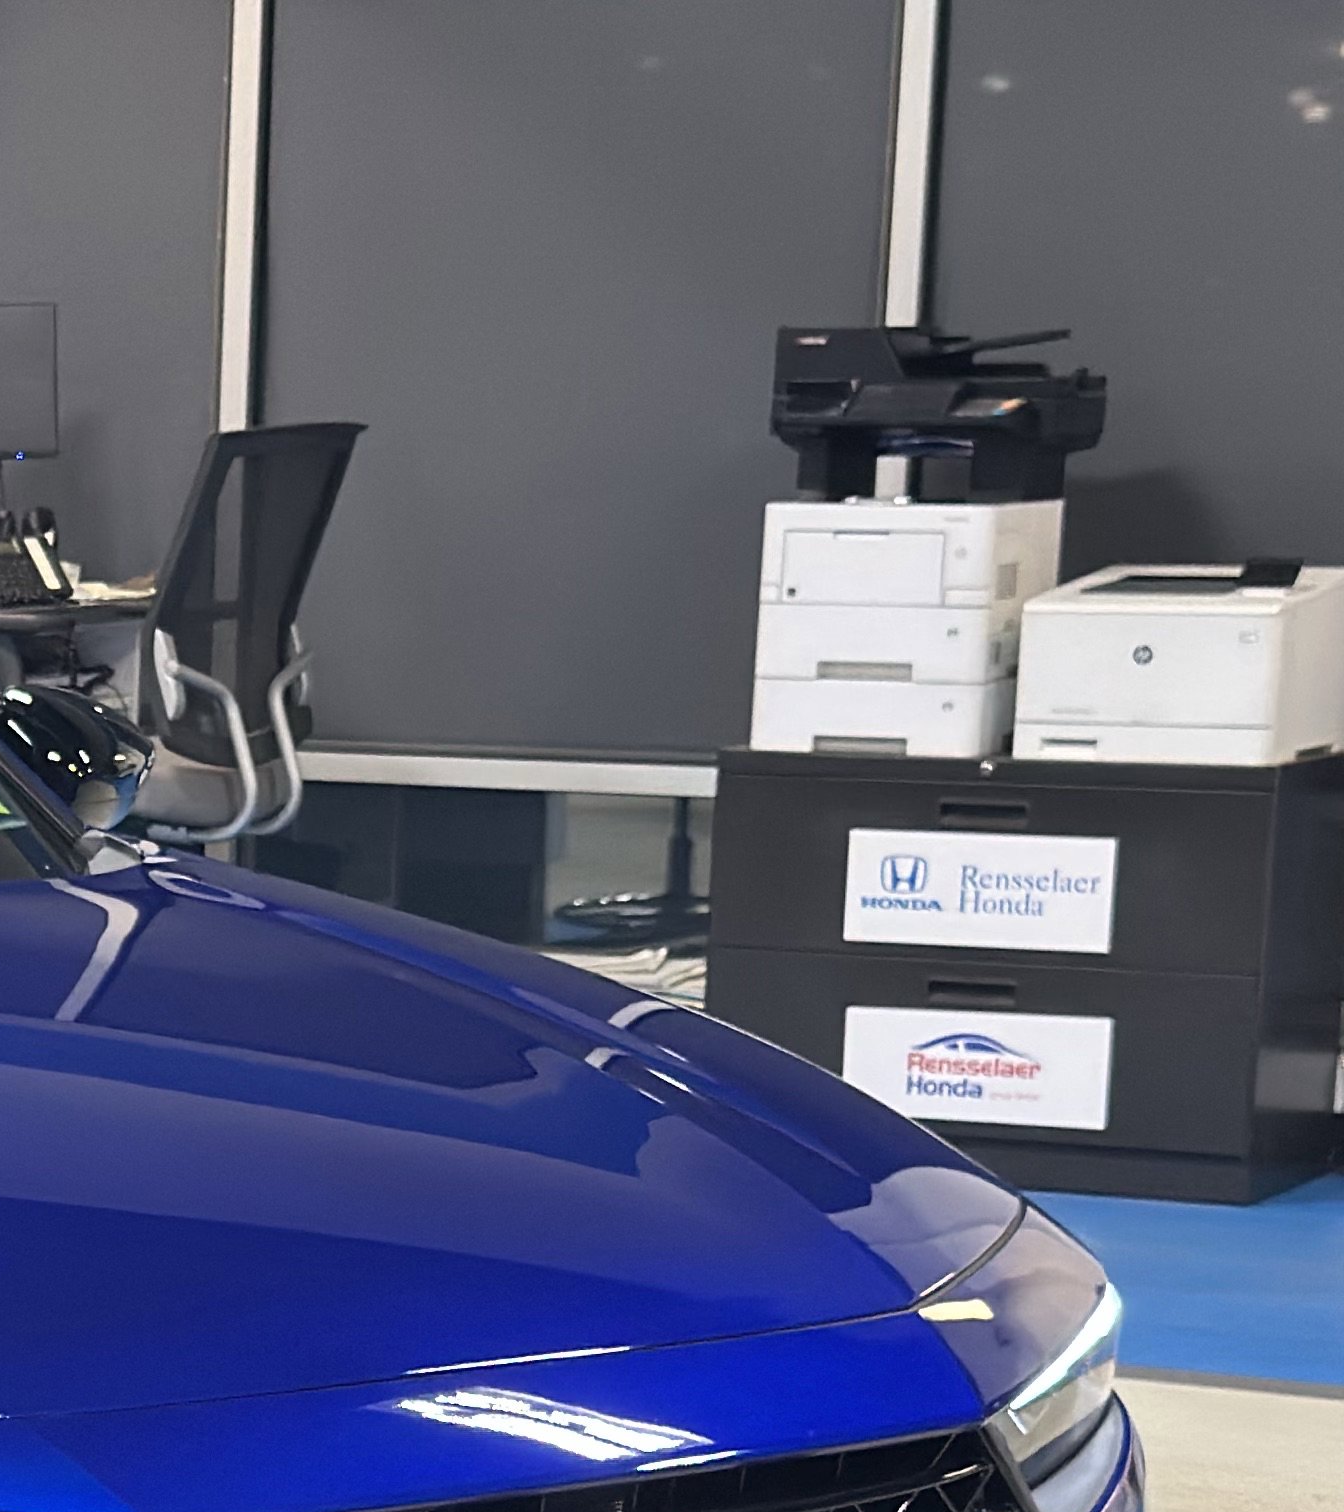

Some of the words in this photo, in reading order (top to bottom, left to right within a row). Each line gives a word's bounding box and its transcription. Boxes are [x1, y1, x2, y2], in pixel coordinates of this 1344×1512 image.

[961, 864, 1101, 894] Rensselaer
[860, 896, 944, 912] HONDA
[959, 890, 1044, 916] Honda
[907, 1052, 1041, 1080] Rensselaer
[906, 1074, 983, 1099] Honda
